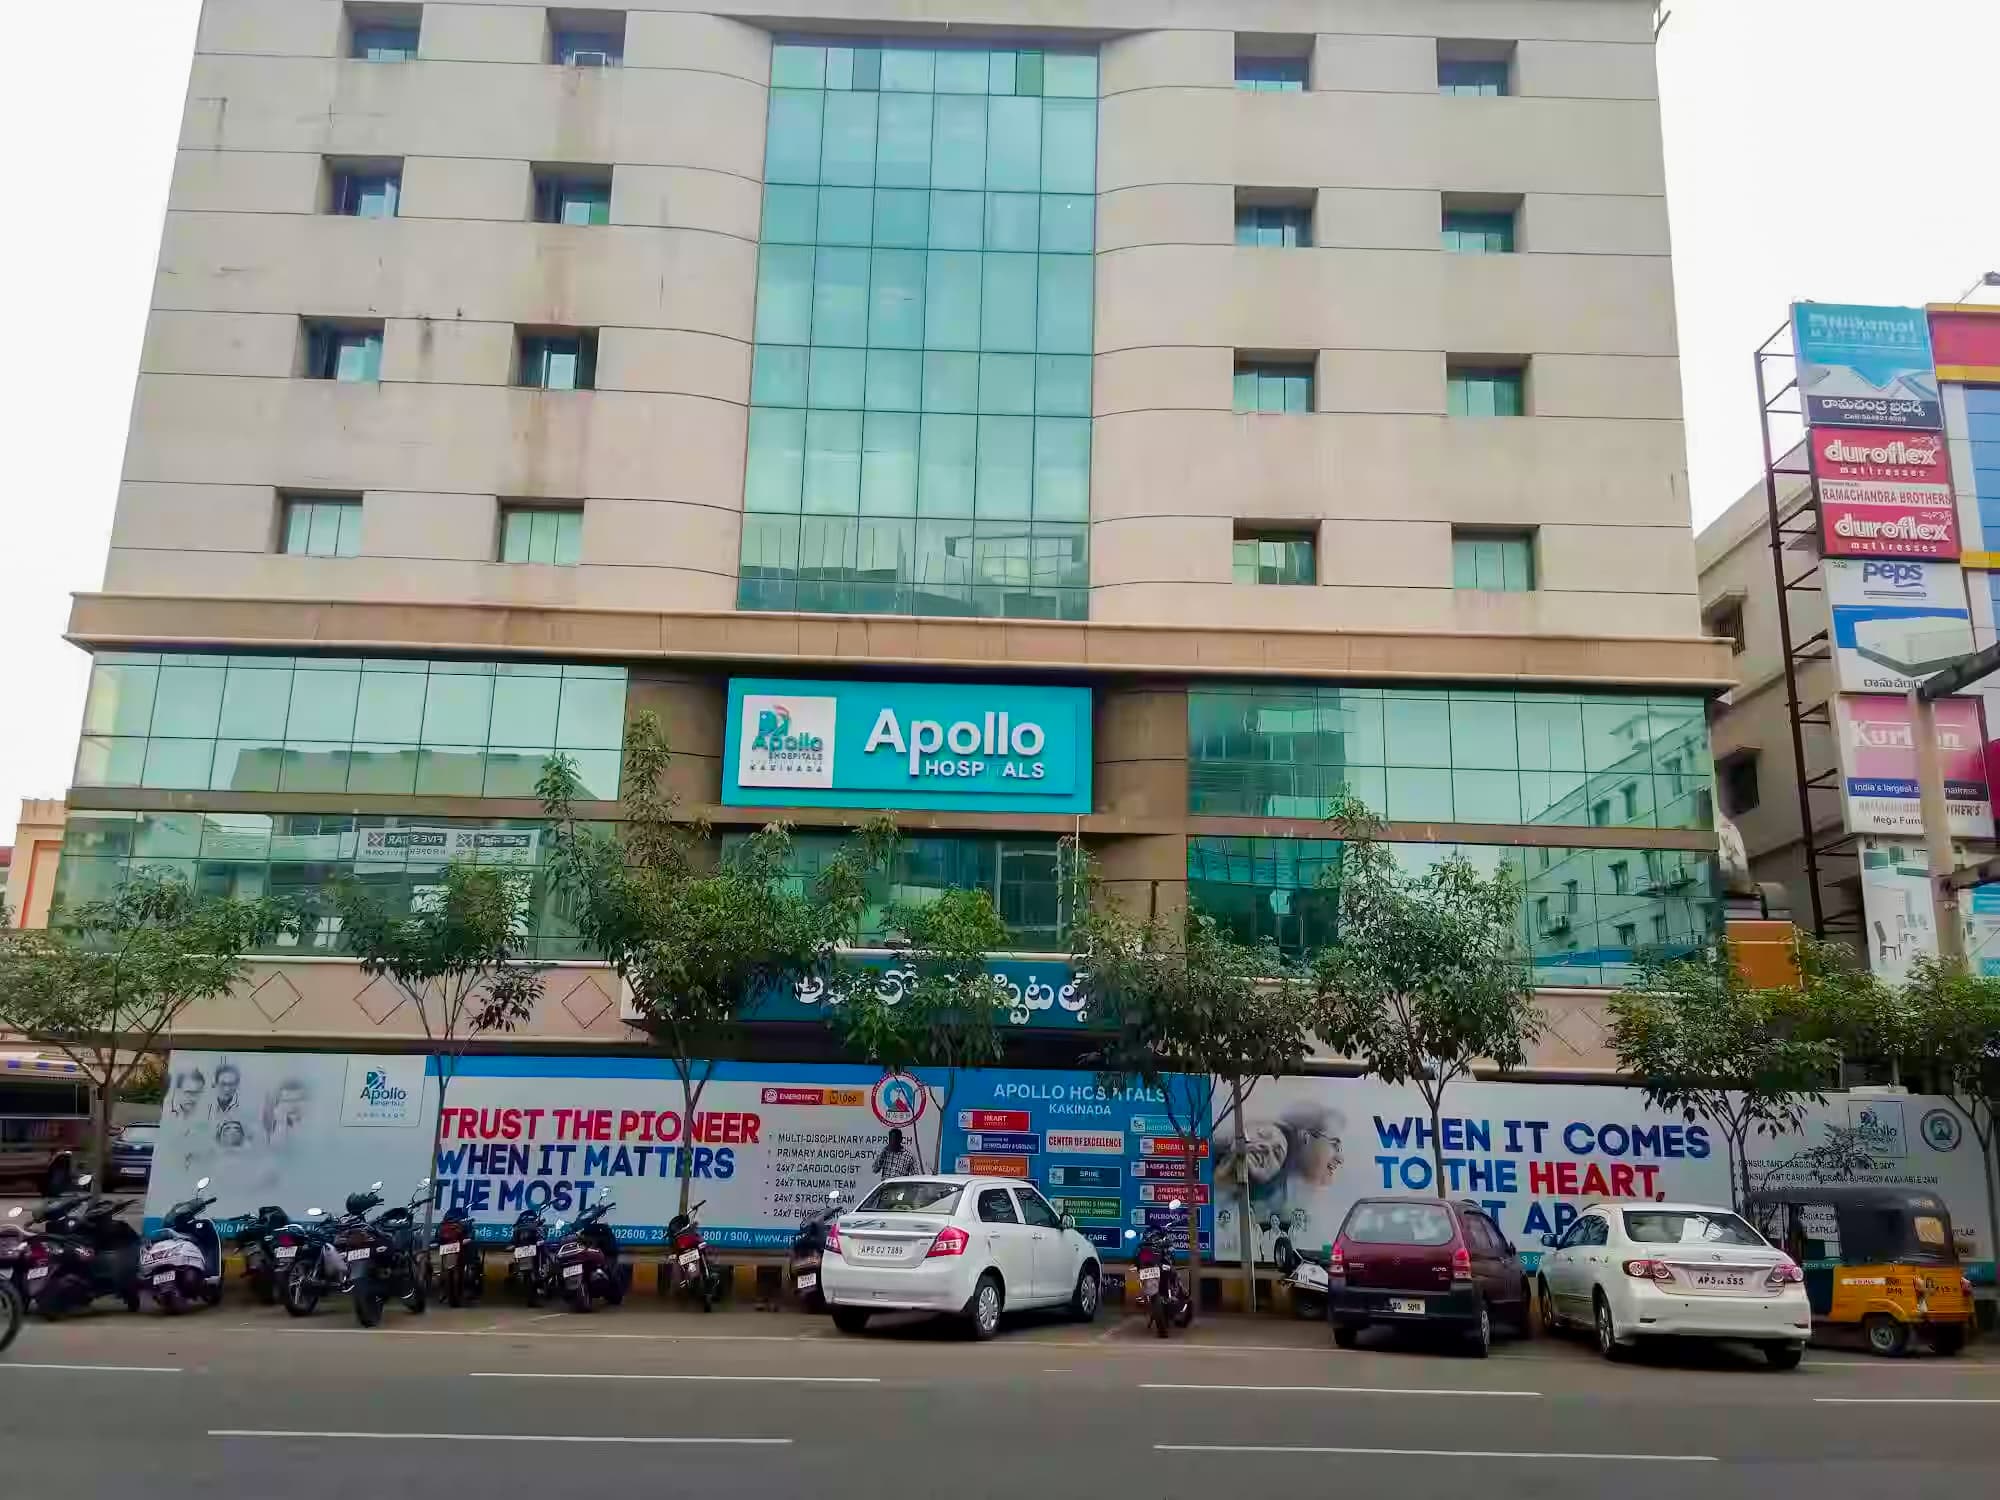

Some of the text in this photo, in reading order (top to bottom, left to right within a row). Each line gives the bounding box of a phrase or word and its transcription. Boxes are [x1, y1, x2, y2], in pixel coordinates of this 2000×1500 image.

[1823, 440, 1937, 465] duroflex
[1839, 465, 1926, 477] mattresses
[1823, 487, 1896, 503] RAMACHANDRA
[1834, 513, 1952, 541] duroflex
[1863, 561, 1924, 583] peps
[751, 731, 823, 759] Apollo
[863, 708, 1045, 776] Apollo
[925, 759, 1045, 778] HOSPALS
[1855, 782, 1881, 792] India's
[1884, 784, 1913, 794] largest
[1873, 815, 1897, 826] Mega
[360, 1087, 407, 1105] Apollo
[994, 1083, 1064, 1100] APOLLO
[1049, 1103, 1112, 1116] KAKINADA
[440, 1108, 761, 1144] TRUST THE PIONEER
[778, 1133, 912, 1145] MULTI-DISCIPLINARY APPRCH
[1372, 1115, 1711, 1159] WHEN IT COMES
[436, 1143, 530, 1175] WHEN
[537, 1144, 577, 1175] IT
[777, 1148, 877, 1160] PRIMARY ANGIOPLASTY
[797, 1164, 861, 1174] CARDIOLOGIST
[796, 1179, 831, 1189] TRAUMA
[834, 1180, 856, 1189] TEAM
[1374, 1156, 1666, 1202] TO THE HEART,
[434, 1178, 595, 1212] THE MOST
[1088, 1233, 1108, 1241] CARE
